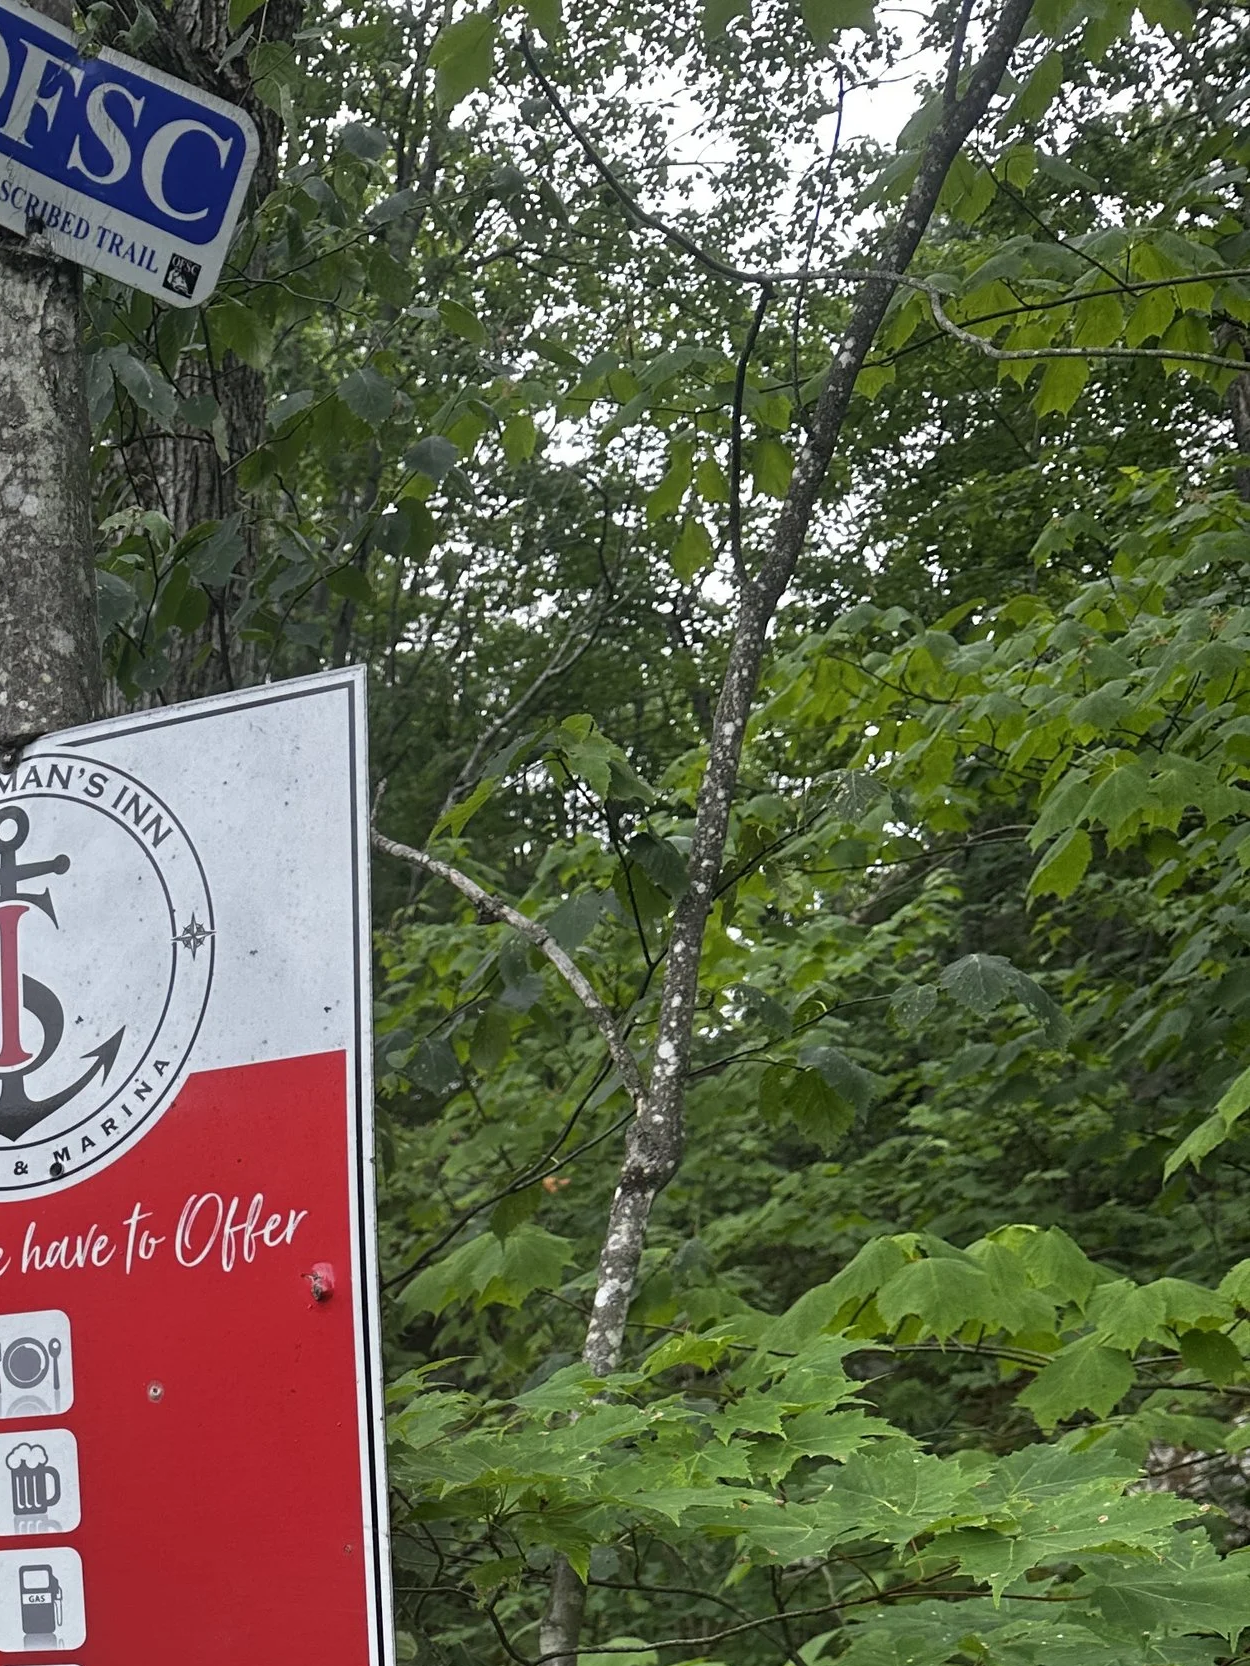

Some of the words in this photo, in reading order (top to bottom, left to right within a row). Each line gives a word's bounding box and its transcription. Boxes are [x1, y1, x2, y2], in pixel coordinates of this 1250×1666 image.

[96, 225, 159, 273] TRAIL
[112, 786, 173, 849] INN
[13, 1160, 29, 1177] &
[52, 1056, 171, 1166] MARINA
[20, 1221, 116, 1275] have
[123, 1202, 166, 1274] to
[174, 1192, 309, 1272] Offer
[28, 1594, 46, 1603] GAS
